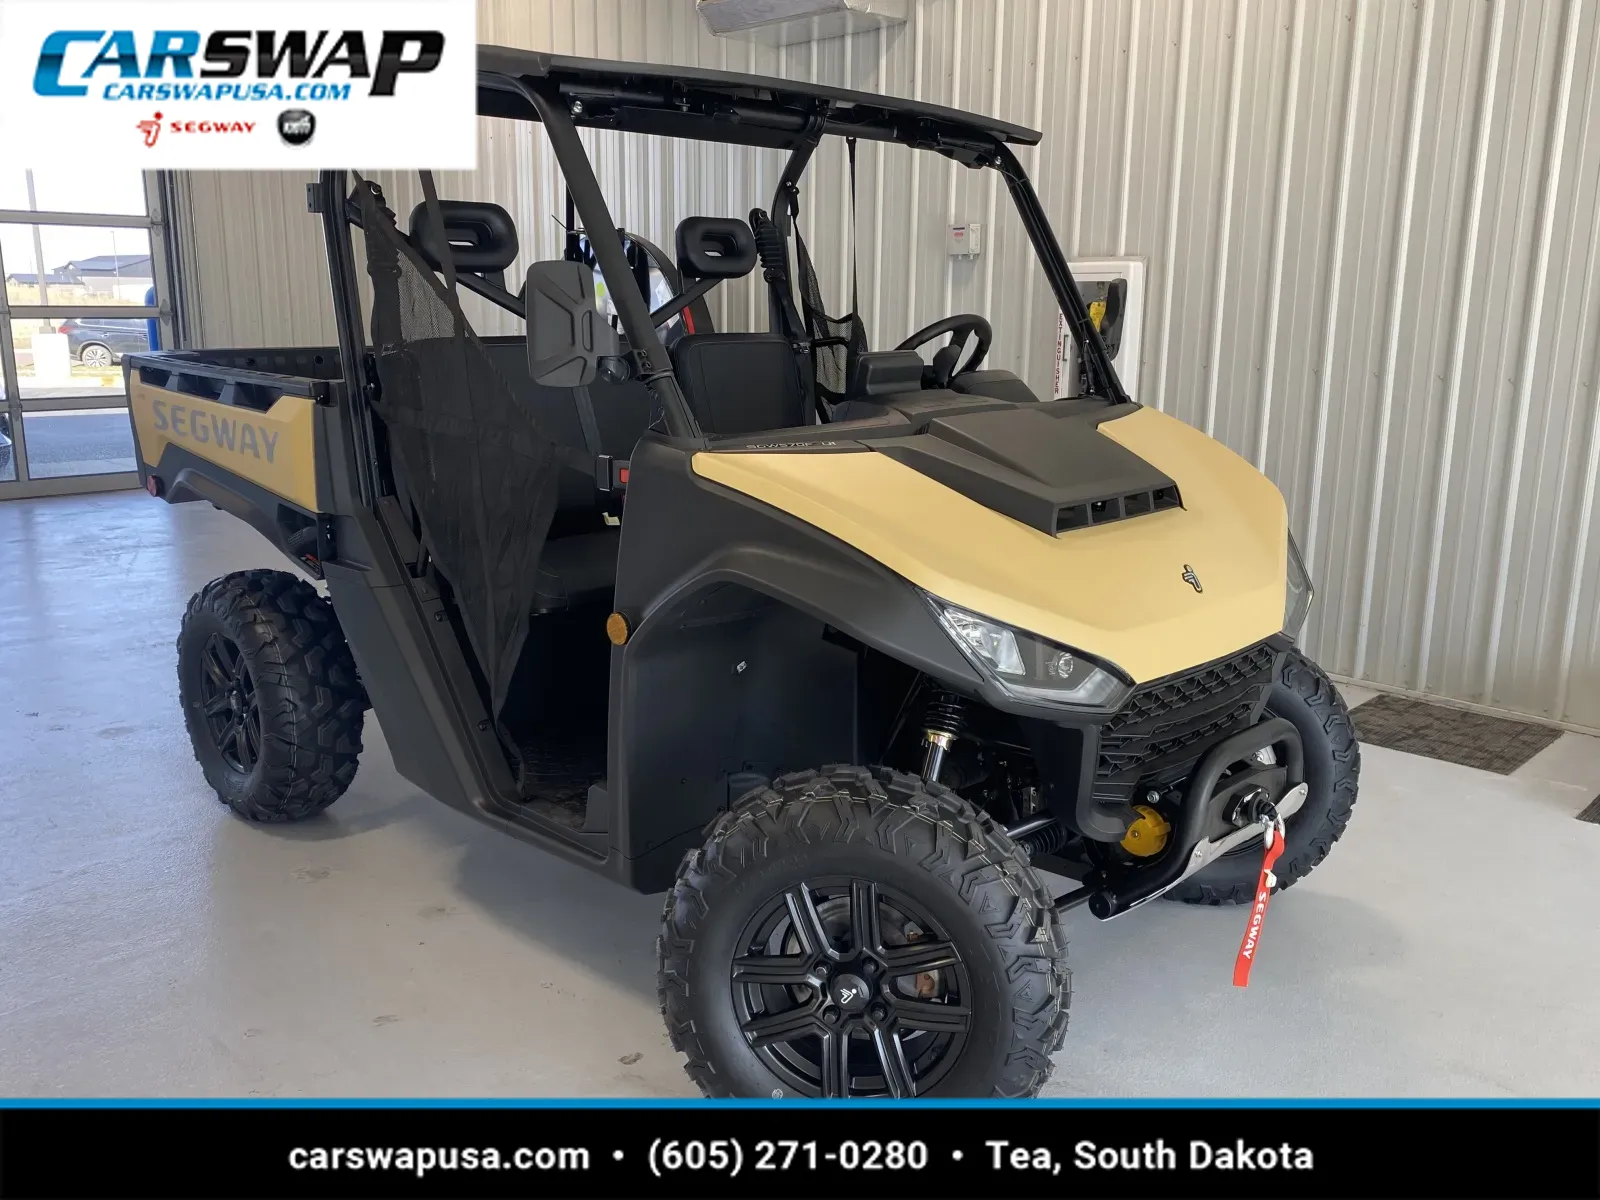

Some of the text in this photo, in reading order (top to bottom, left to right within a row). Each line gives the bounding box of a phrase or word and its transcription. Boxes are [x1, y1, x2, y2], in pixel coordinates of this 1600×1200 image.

[1054, 313, 1064, 395] EXTINGUISHER
[152, 400, 279, 464] SEGWAY
[1243, 891, 1267, 959] SEGWAY
